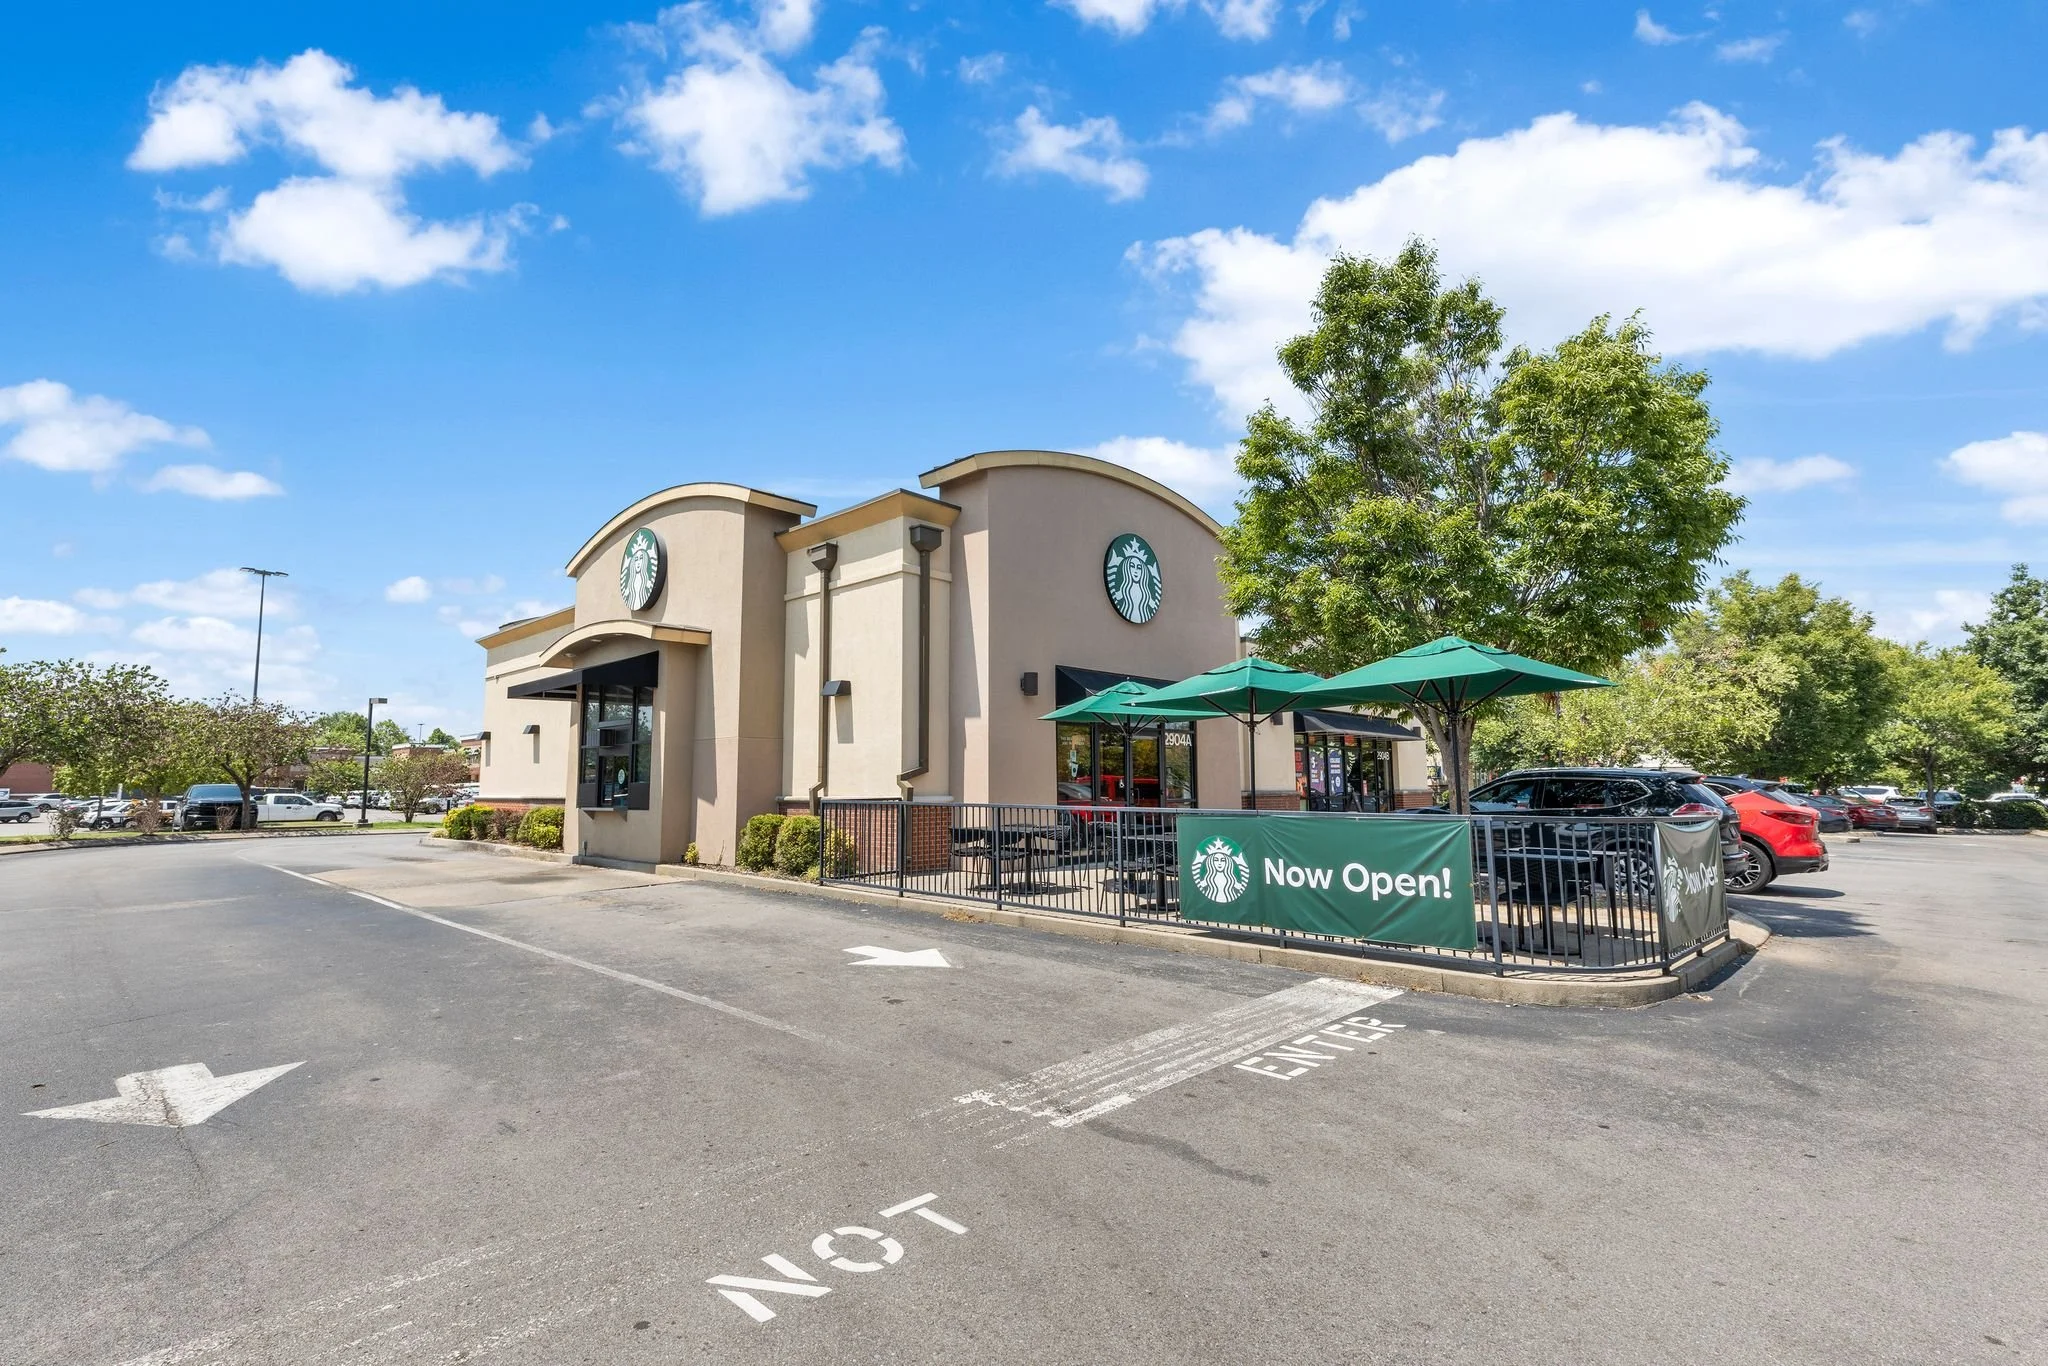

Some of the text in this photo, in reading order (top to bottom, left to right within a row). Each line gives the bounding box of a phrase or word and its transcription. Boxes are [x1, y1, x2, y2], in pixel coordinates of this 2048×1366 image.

[1164, 732, 1192, 747] 2904A
[1263, 857, 1452, 901] Now Open!
[705, 1016, 1407, 1323] NOT ENTER
